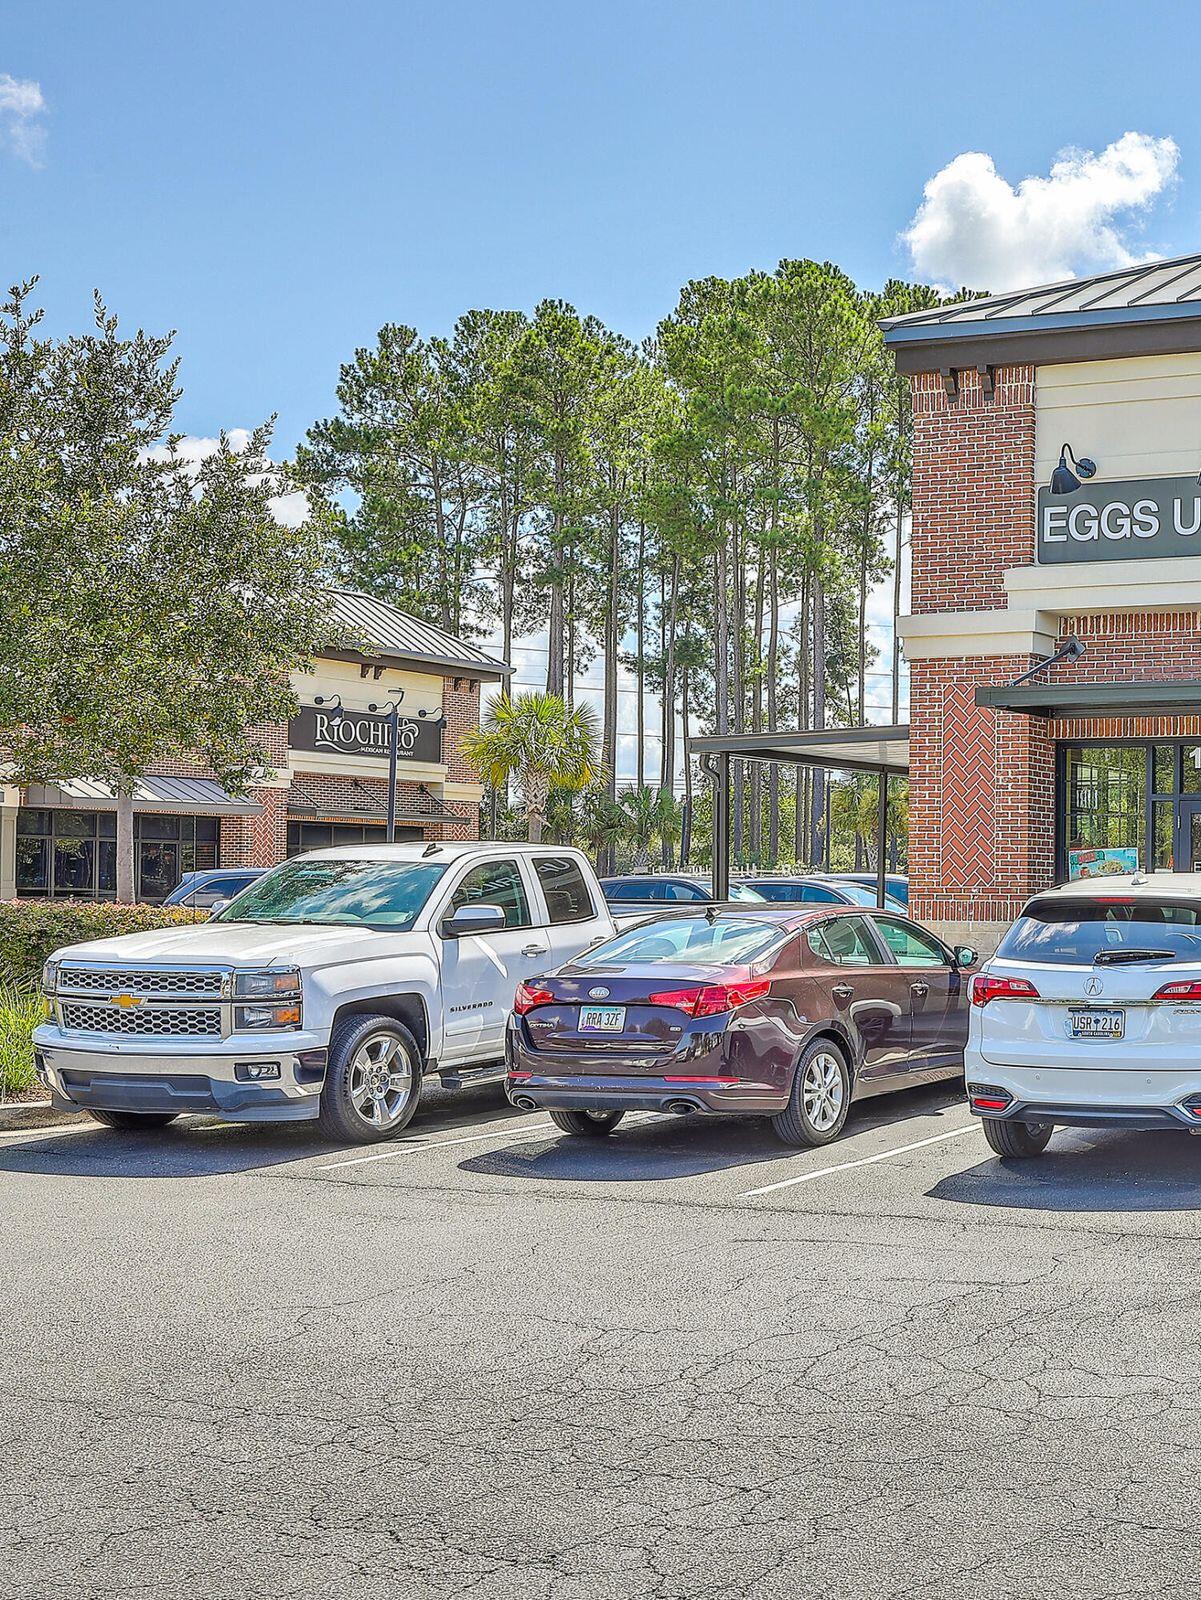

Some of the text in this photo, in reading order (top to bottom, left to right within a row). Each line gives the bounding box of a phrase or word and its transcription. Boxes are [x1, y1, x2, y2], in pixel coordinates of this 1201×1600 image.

[1043, 498, 1160, 544] EGGS
[450, 1001, 493, 1013] SILVERADO
[586, 1012, 602, 1026] RRA
[1073, 1016, 1120, 1031] USR 216
